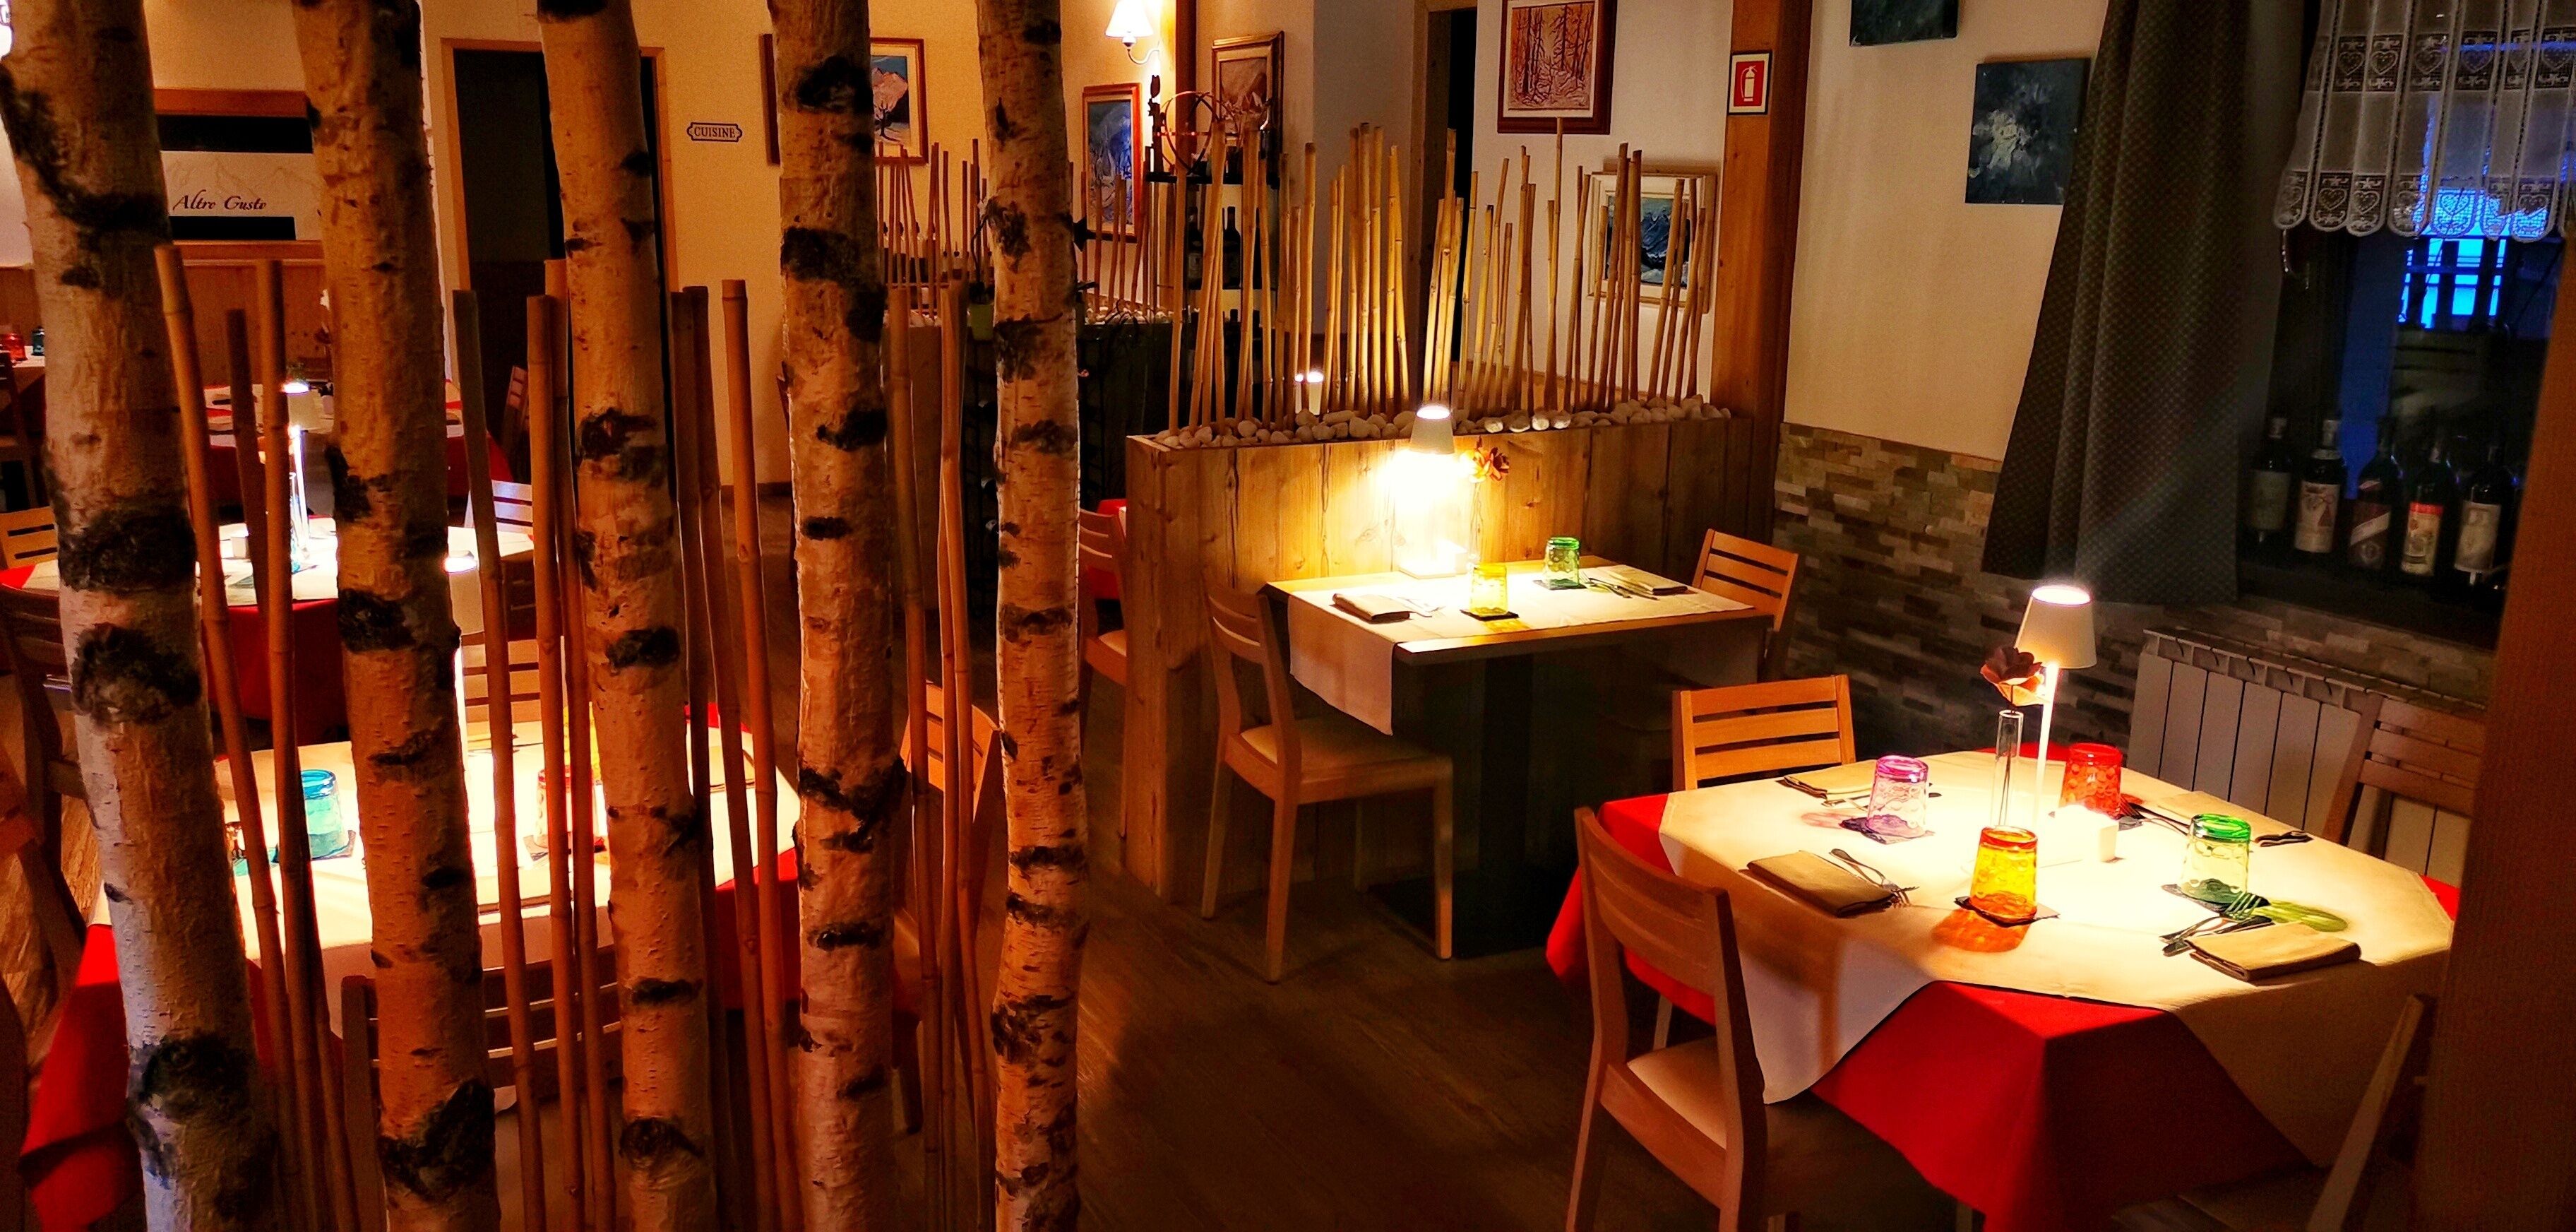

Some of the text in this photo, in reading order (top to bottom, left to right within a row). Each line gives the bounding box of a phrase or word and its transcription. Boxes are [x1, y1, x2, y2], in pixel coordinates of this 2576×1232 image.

[693, 126, 736, 138] CUISINE
[173, 189, 267, 211] Altro Gusto
